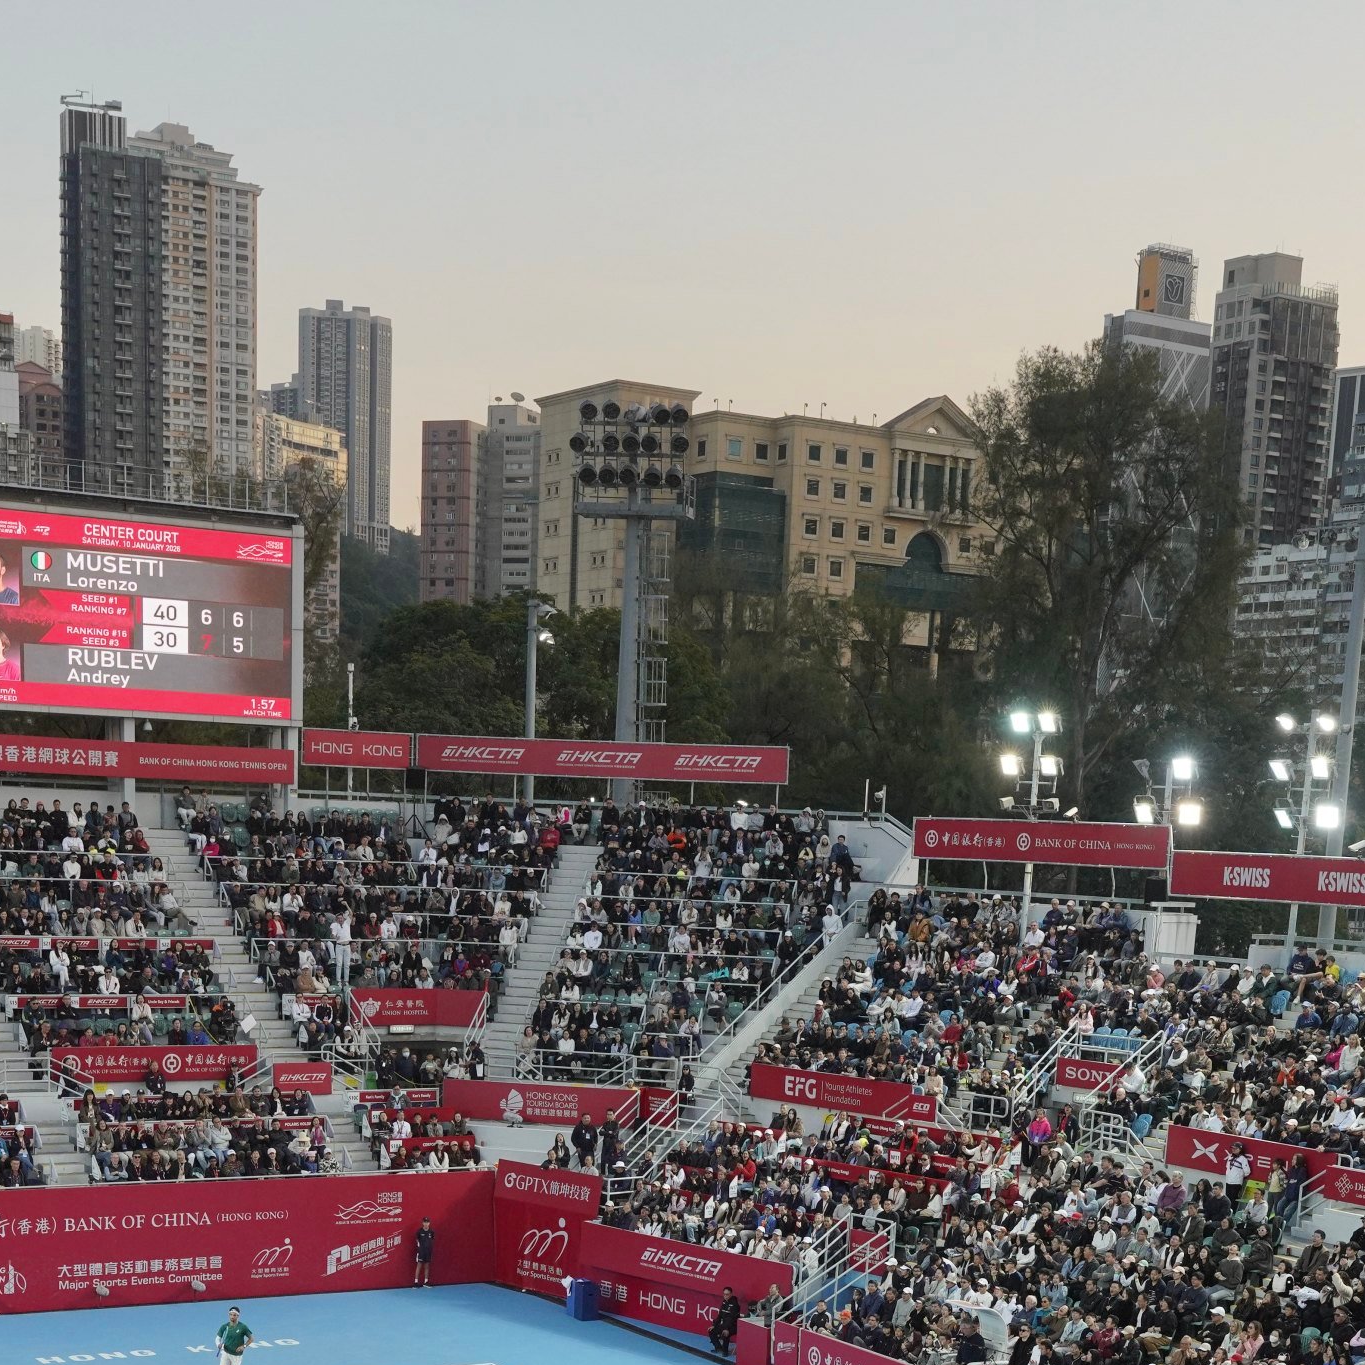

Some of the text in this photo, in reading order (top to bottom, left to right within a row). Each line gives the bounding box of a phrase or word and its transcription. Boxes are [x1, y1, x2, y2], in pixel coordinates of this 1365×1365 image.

[84, 523, 179, 544] CENTER COURT
[66, 552, 164, 577] MUSETTI
[33, 573, 138, 591] ITA Lorenzo
[82, 594, 118, 604] SEED #1
[71, 604, 127, 616] RANKING #7
[153, 604, 244, 628] 40 6 6
[67, 626, 128, 638] RANKING #16
[82, 637, 119, 647] SEED #3
[153, 631, 244, 653] 30 7 5
[68, 648, 158, 672] RUBLEV
[67, 669, 130, 689] Andrey
[243, 709, 266, 717] MATCH
[250, 698, 276, 710] 1:57
[311, 741, 403, 757] HONG KONG
[454, 746, 762, 768] HKCTA HKCTA HKCTA
[139, 756, 287, 771] BANK OF CHINA HONG KONG TENNIS OPEN
[526, 1091, 578, 1102] HONG KONG
[784, 1075, 873, 1100] EFG Young Athletes
[526, 1100, 578, 1110] TOURISM BOARD
[824, 1093, 862, 1107] Foundation
[64, 1216, 116, 1232] BANK
[121, 1214, 146, 1230] OF
[150, 1211, 212, 1228] CHINA
[216, 1211, 252, 1224] (HONG
[255, 1208, 290, 1222] KONG)
[57, 1255, 223, 1278] 大型體育活動事務委員會
[654, 1249, 723, 1276] HKCTA
[58, 1272, 223, 1291] Major Sports Events Committee
[35, 1338, 301, 1365] HONG KNG
